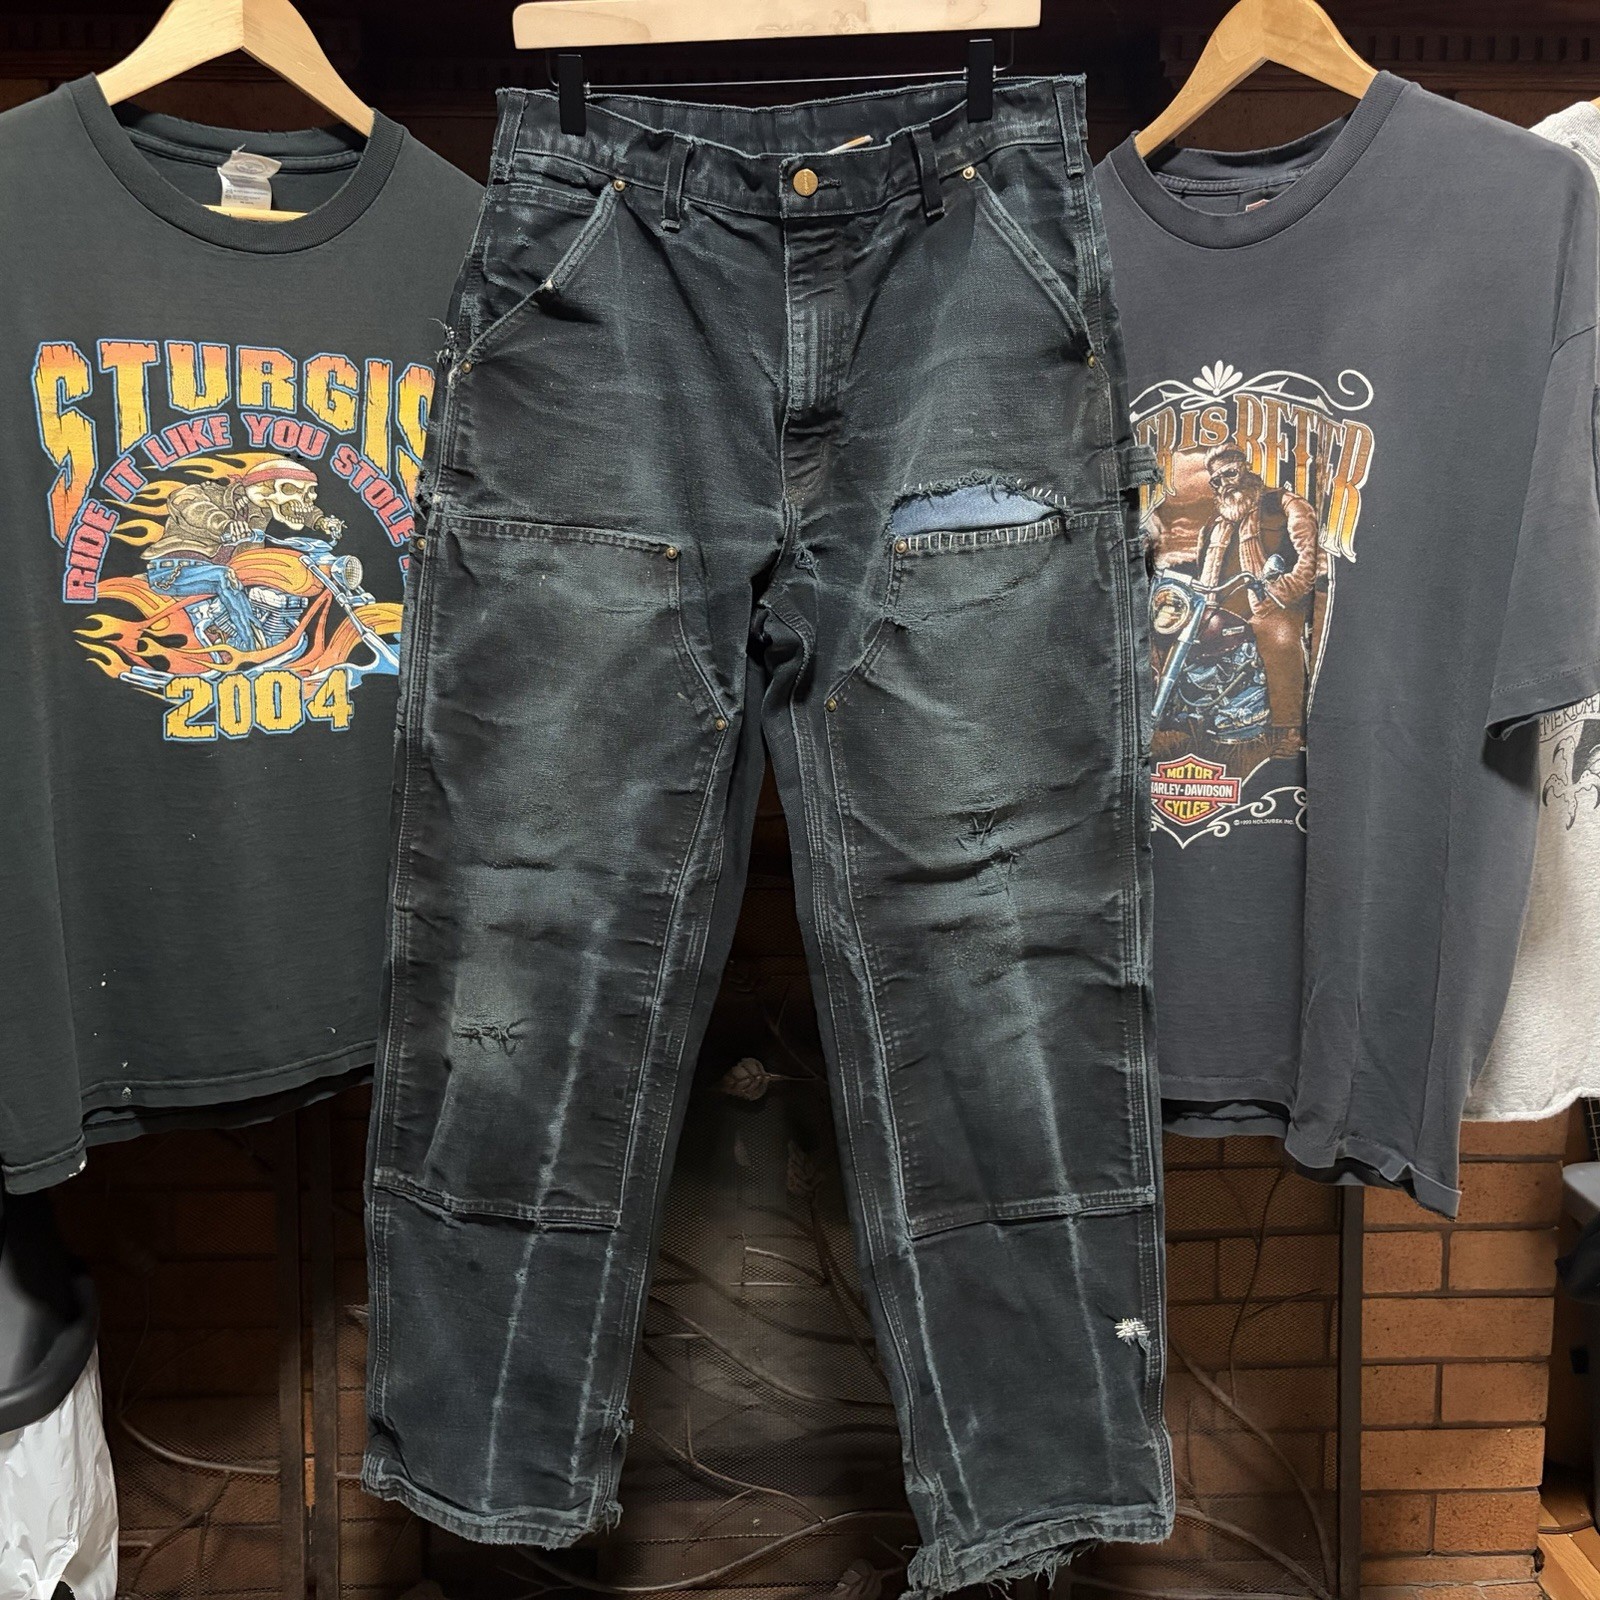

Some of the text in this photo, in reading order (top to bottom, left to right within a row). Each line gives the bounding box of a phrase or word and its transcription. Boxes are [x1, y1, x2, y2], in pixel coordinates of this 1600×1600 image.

[32, 339, 437, 547] STURGIS
[1178, 406, 1229, 452] IS
[1232, 394, 1376, 564] BETER
[63, 412, 416, 604] RIDE IT LIKE YOU STOLE
[163, 668, 354, 741] 2004
[1164, 800, 1210, 819] CYCLES
[1166, 762, 1213, 779] MOTOR
